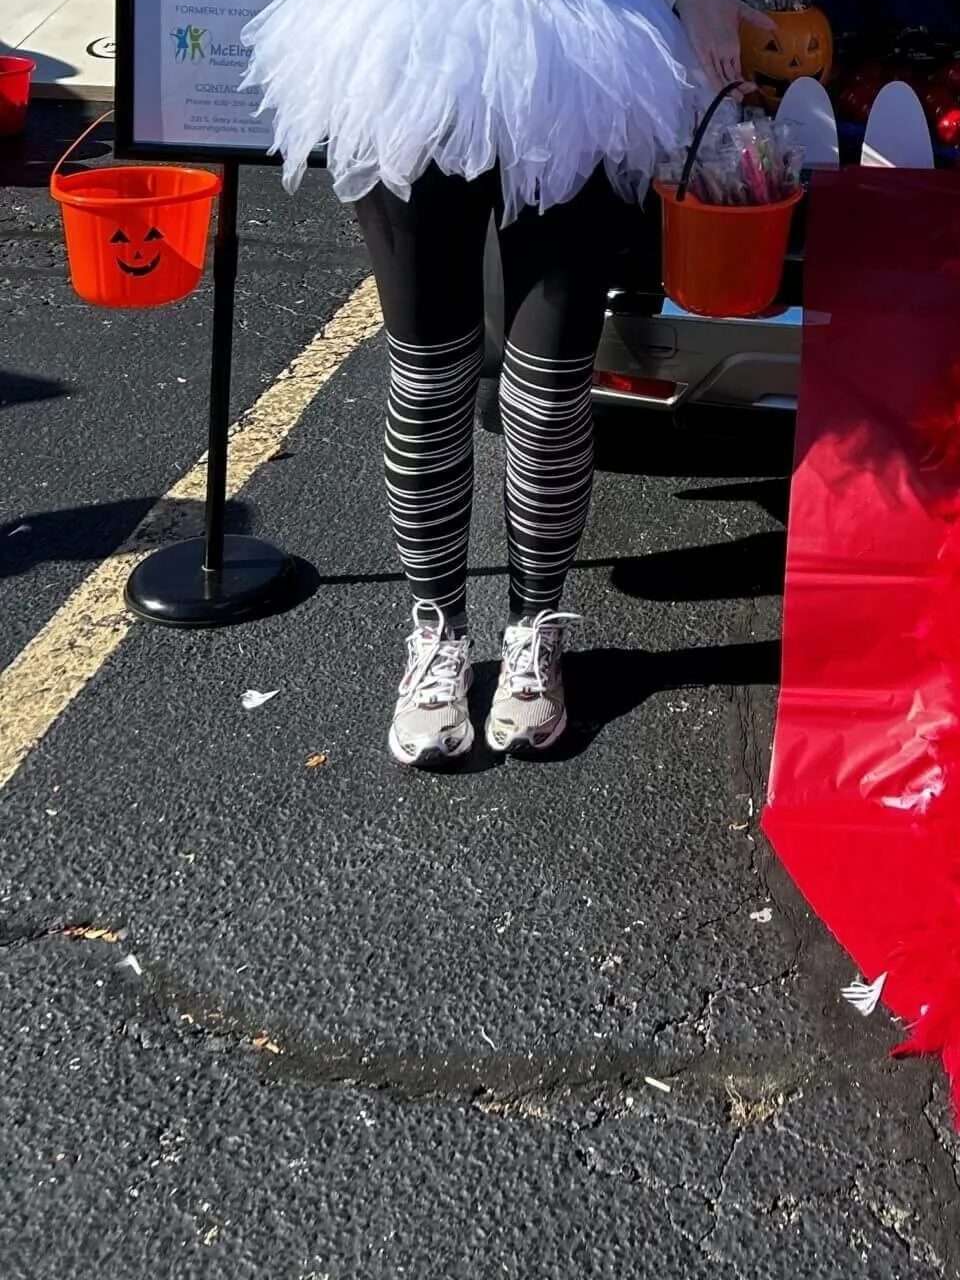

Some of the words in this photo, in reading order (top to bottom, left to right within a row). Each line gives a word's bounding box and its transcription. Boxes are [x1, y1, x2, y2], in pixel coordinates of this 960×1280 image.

[175, 5, 225, 17] FORMERLY
[210, 43, 253, 58] McElro
[195, 83, 244, 95] CONTAC
